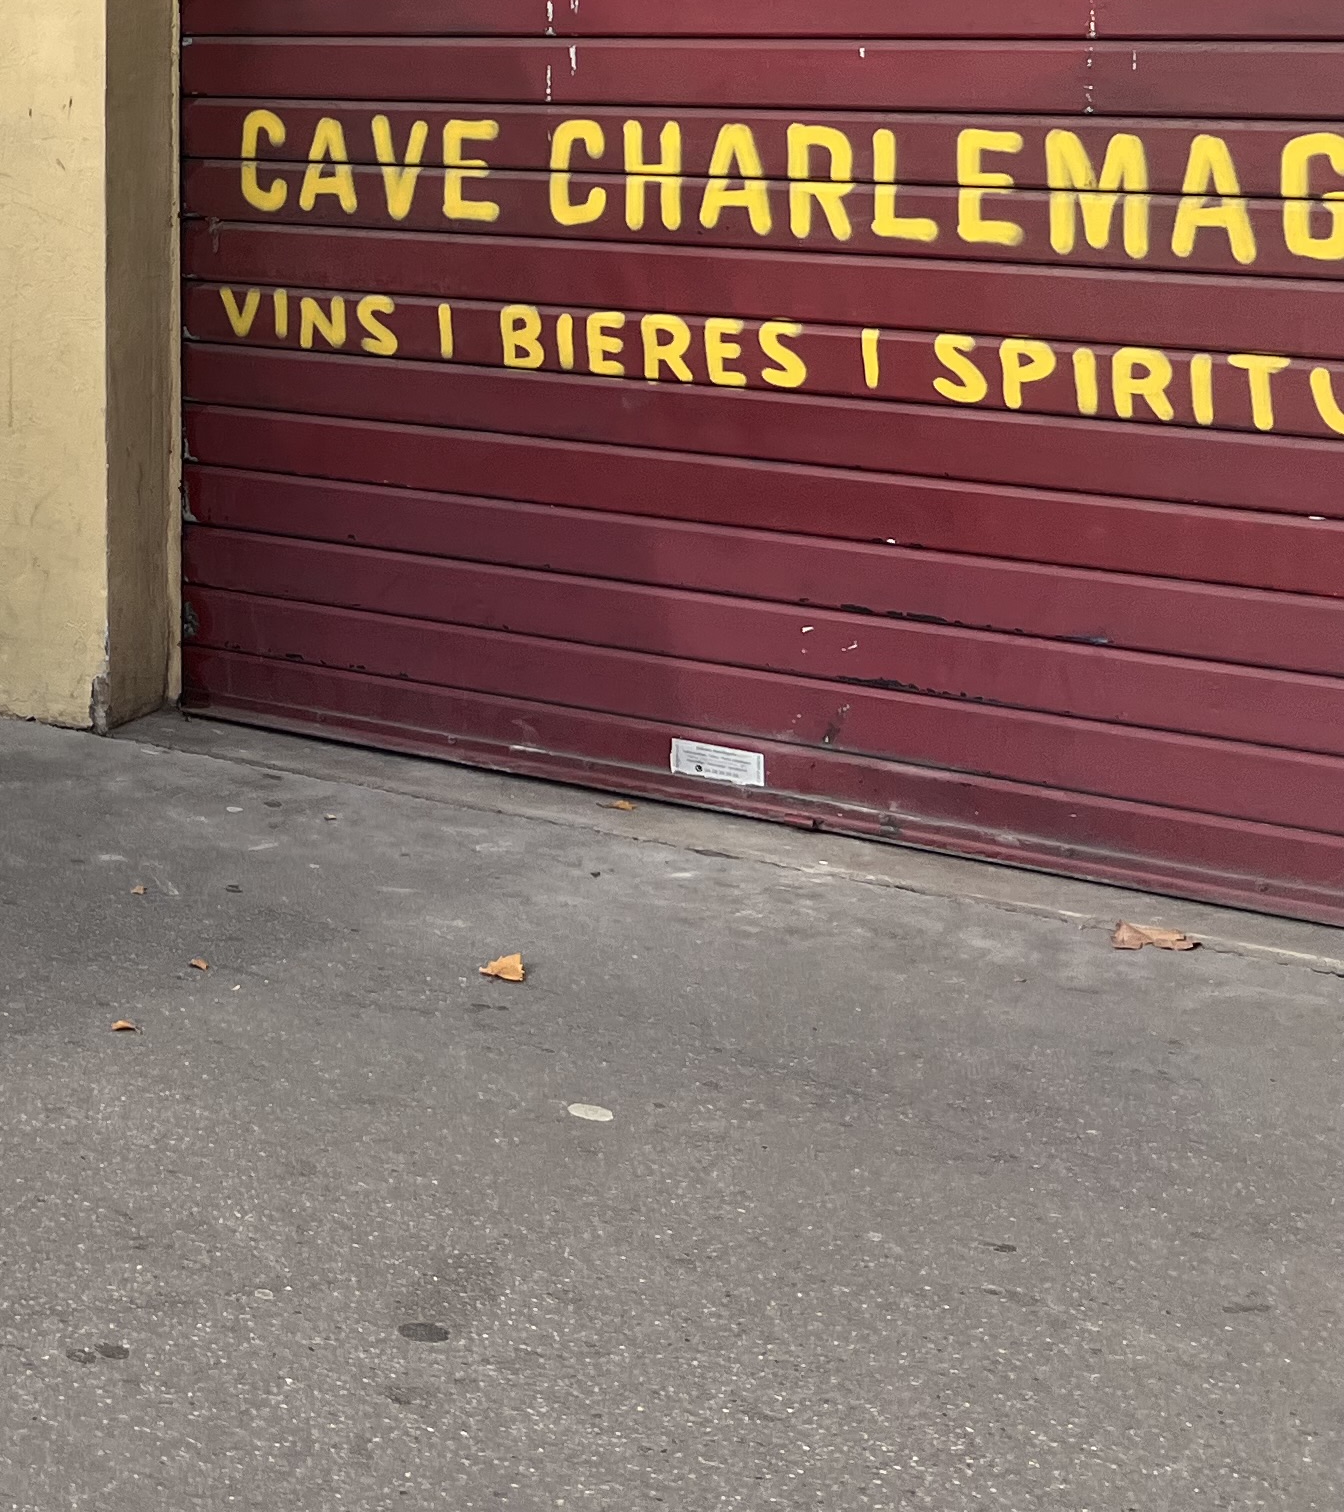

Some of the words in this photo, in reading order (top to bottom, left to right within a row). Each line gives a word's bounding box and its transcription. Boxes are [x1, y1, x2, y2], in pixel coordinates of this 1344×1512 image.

[240, 108, 499, 222] CAVE
[549, 119, 1344, 263] CHARLEMAG
[219, 289, 398, 357] VINS
[500, 306, 808, 389] BIERES
